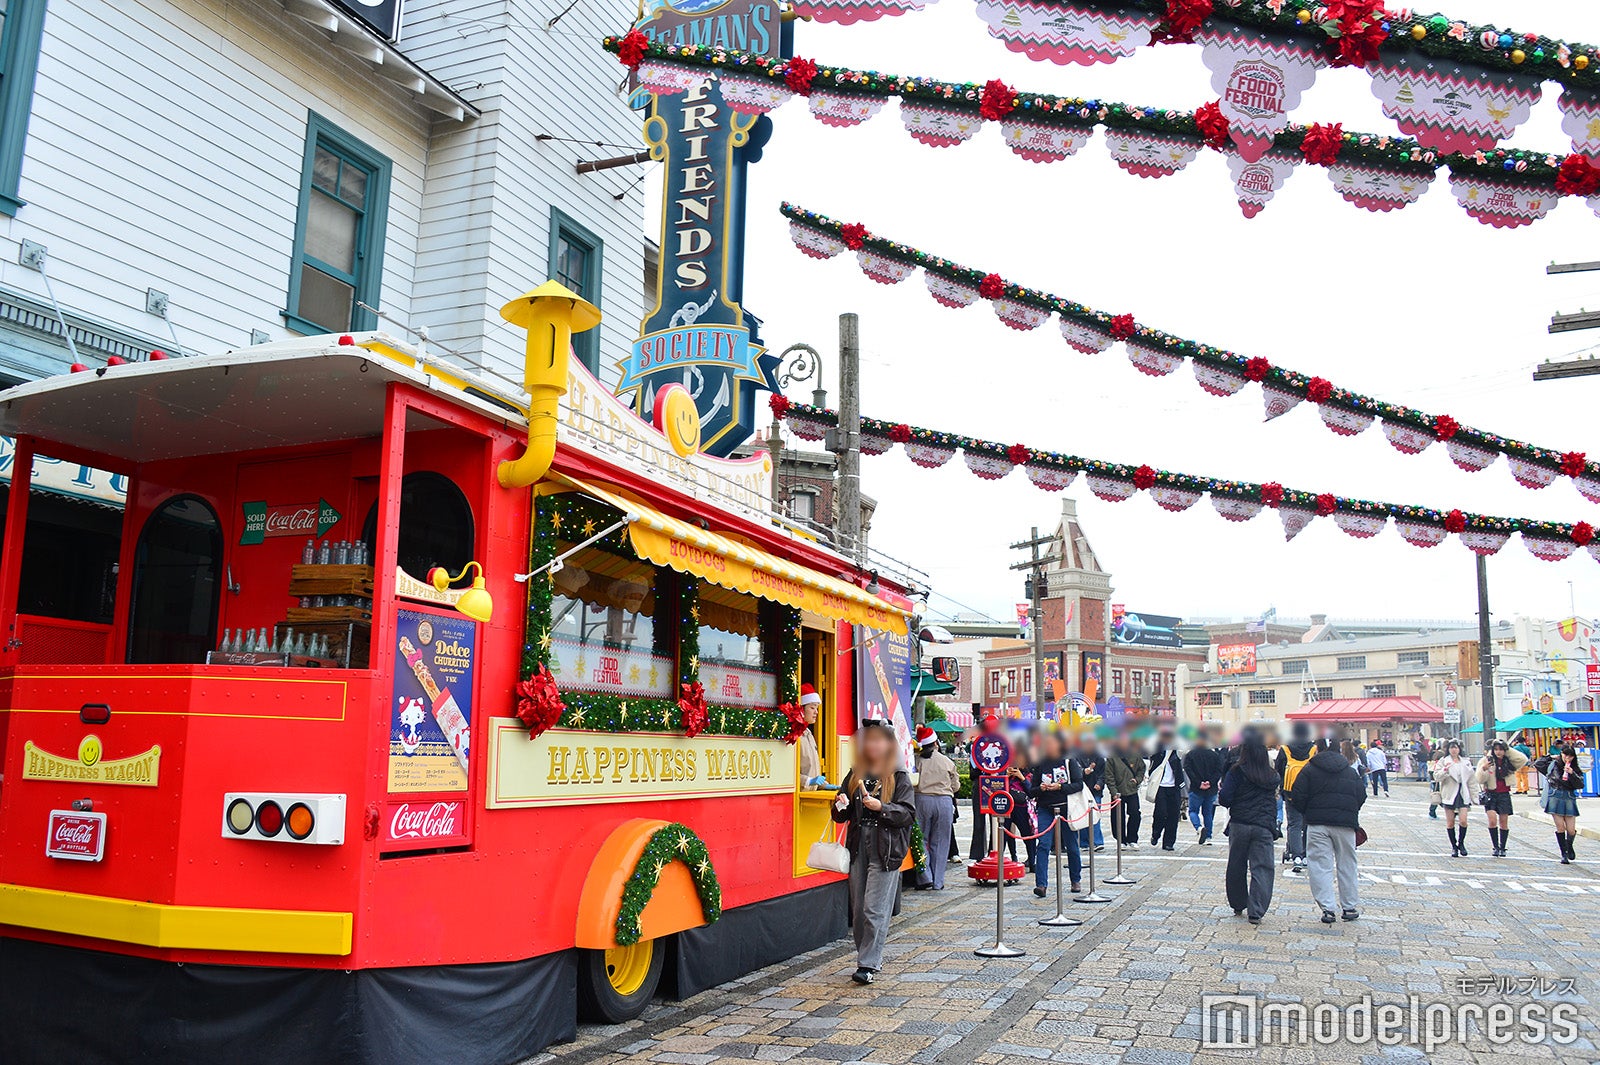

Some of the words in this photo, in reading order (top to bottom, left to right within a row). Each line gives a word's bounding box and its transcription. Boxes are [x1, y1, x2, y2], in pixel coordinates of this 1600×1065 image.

[1231, 65, 1260, 79] UNIVERSAL
[1238, 75, 1278, 97] FOOD
[1225, 87, 1285, 114] FESTIVAL
[674, 72, 718, 288] FRIENDS
[1237, 179, 1274, 192] FESTIVAL
[1245, 173, 1270, 184] FOOD
[1487, 198, 1518, 209] FESTIVAL
[1493, 192, 1514, 202] FOOD
[640, 331, 739, 369] SOCIETY
[566, 373, 698, 482] HAPPINESS
[707, 471, 765, 510] WAGON
[247, 513, 266, 522] SOLD
[266, 508, 318, 532] Coca-Cola
[319, 516, 338, 524] COLD
[322, 508, 333, 516] ICE
[246, 523, 265, 531] HERE
[669, 538, 726, 572] HOTDOGS
[399, 576, 448, 602] HAPPINESS
[435, 640, 470, 658] Dolce
[599, 656, 619, 670] FOOD
[593, 669, 623, 685] FESTIVAL
[725, 674, 740, 687] FOOD
[722, 685, 743, 698] FESTIVAL
[29, 752, 100, 779] HAPPINESS
[104, 756, 154, 782] WAGON
[546, 746, 698, 785] HAPPINESS
[704, 748, 773, 780] WAGON
[390, 802, 459, 839] Coca-Cola
[56, 823, 95, 843] Coca-Cola
